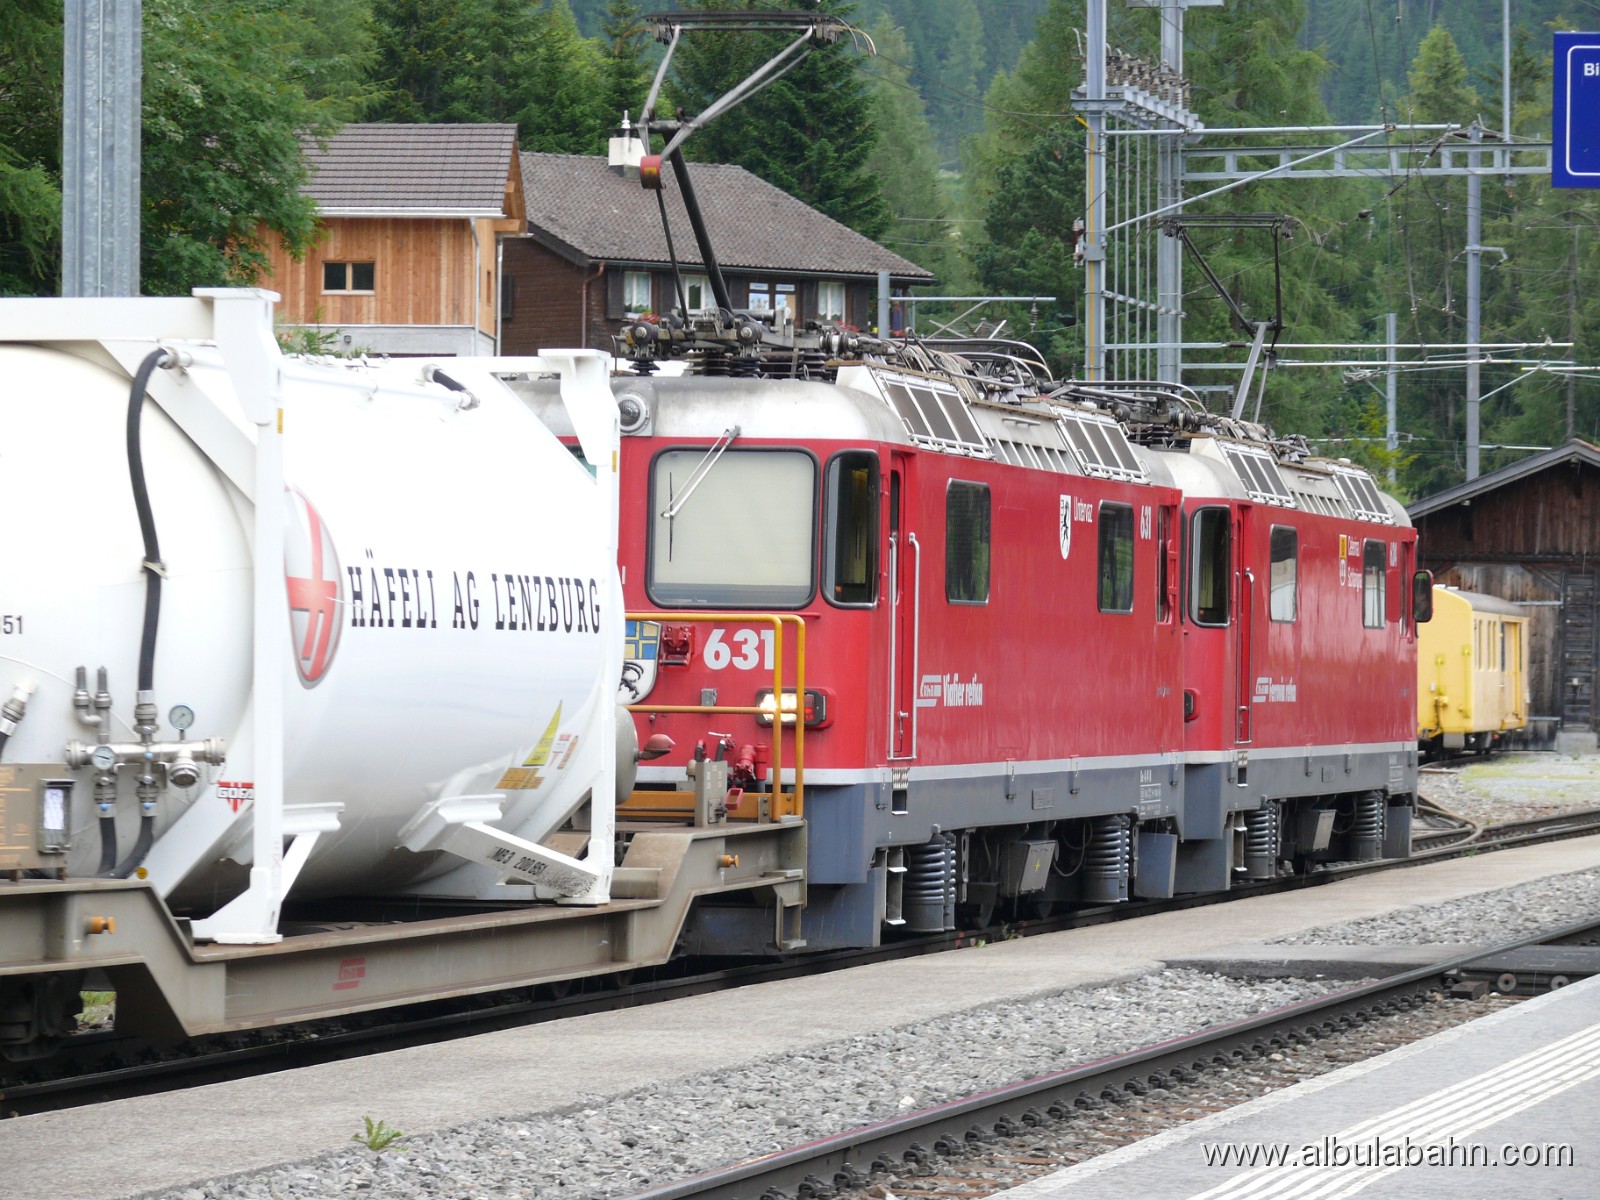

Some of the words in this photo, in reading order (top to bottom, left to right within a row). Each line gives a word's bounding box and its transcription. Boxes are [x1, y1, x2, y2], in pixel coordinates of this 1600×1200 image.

[1073, 496, 1093, 523] Untervaz
[1140, 505, 1152, 540] 631
[347, 548, 437, 629] HÄFELI
[452, 570, 480, 631] AG
[491, 573, 601, 634] LENZBURG
[0, 614, 23, 635] 51
[703, 628, 775, 670] 631
